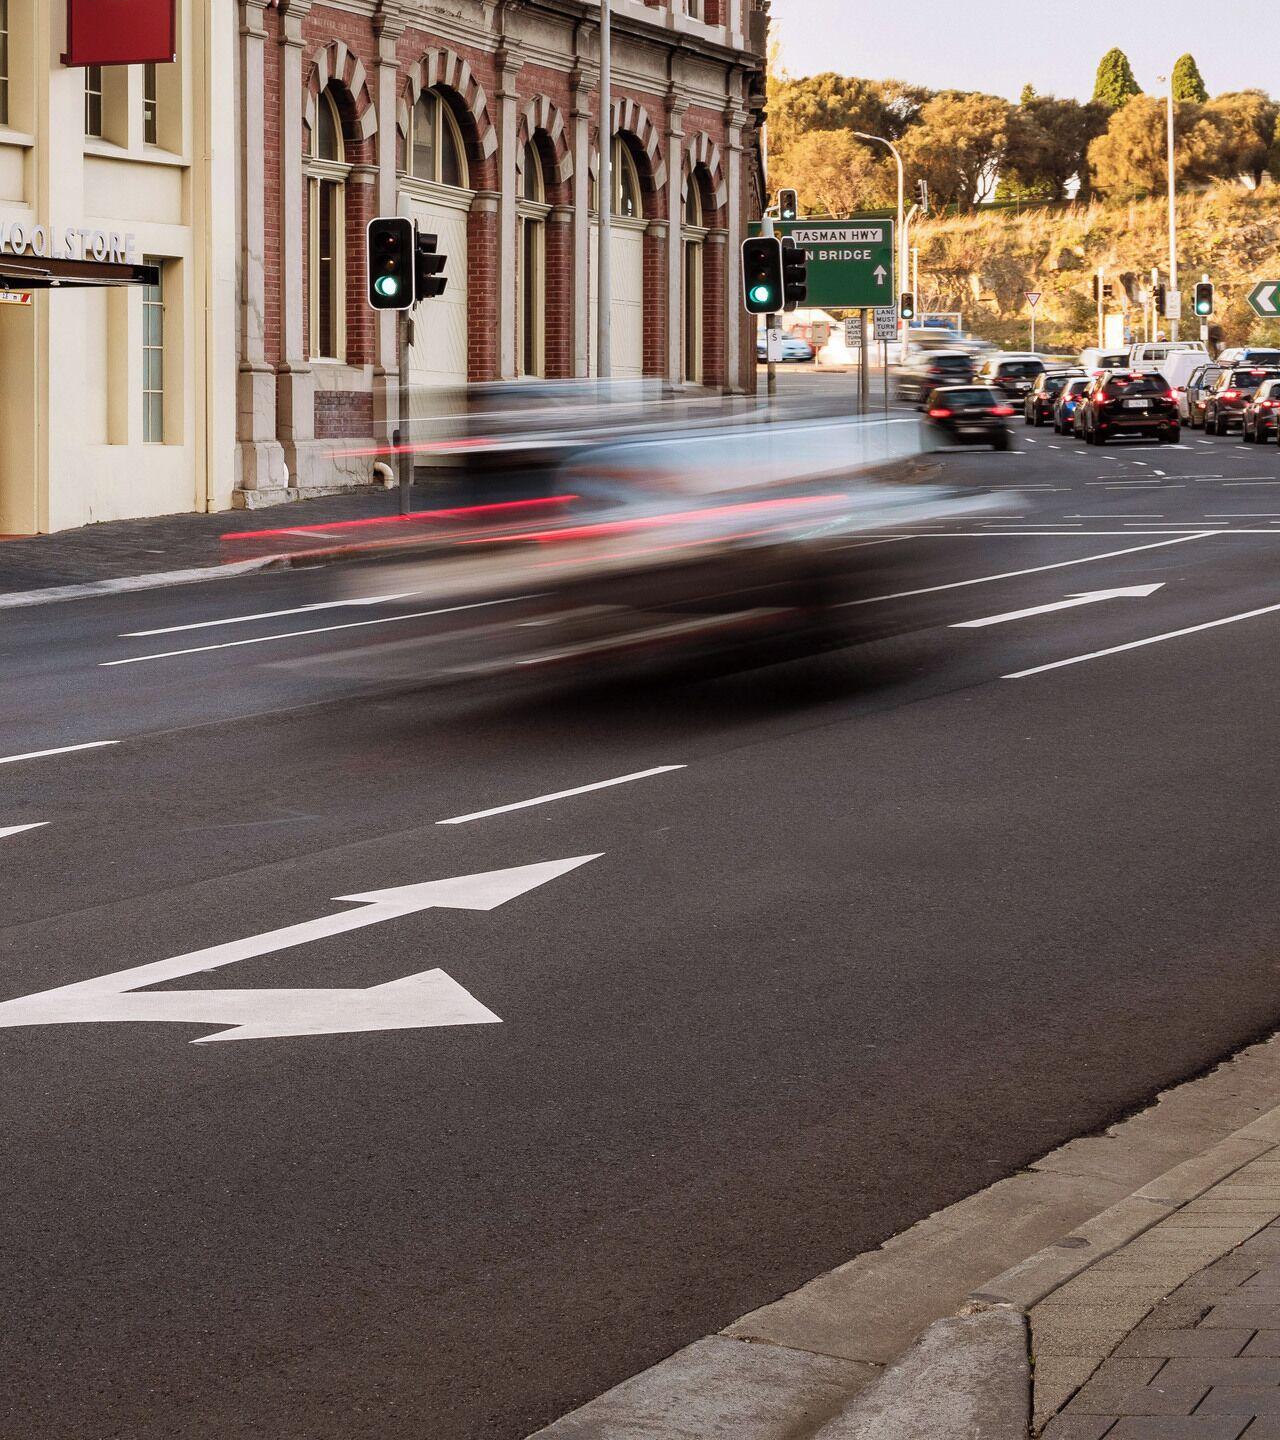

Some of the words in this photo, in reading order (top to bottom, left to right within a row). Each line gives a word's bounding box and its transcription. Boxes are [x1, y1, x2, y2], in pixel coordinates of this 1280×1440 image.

[796, 231, 847, 242] TASMAN
[851, 230, 878, 241] HWY
[819, 250, 872, 260] BRIDGE
[772, 333, 778, 342] S
